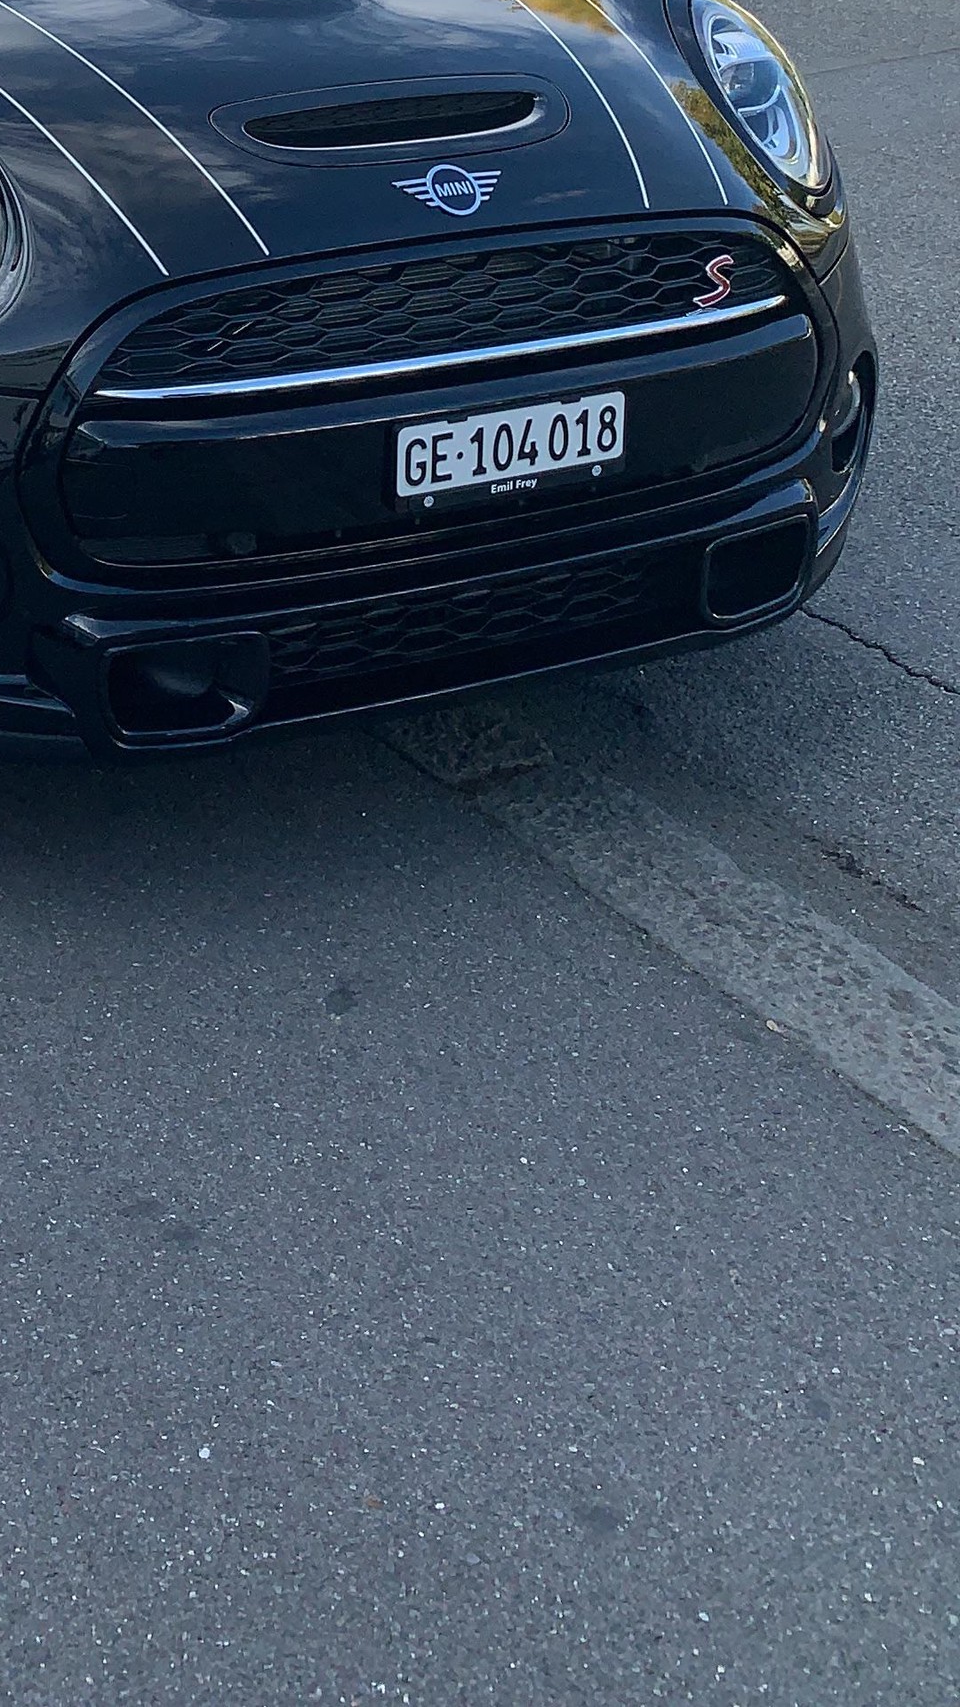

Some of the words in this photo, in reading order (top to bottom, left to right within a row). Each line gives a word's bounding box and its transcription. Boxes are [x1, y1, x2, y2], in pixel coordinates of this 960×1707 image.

[434, 180, 474, 197] MINI
[692, 254, 734, 307] S
[490, 481, 514, 494] Emil
[515, 477, 538, 490] Frey
